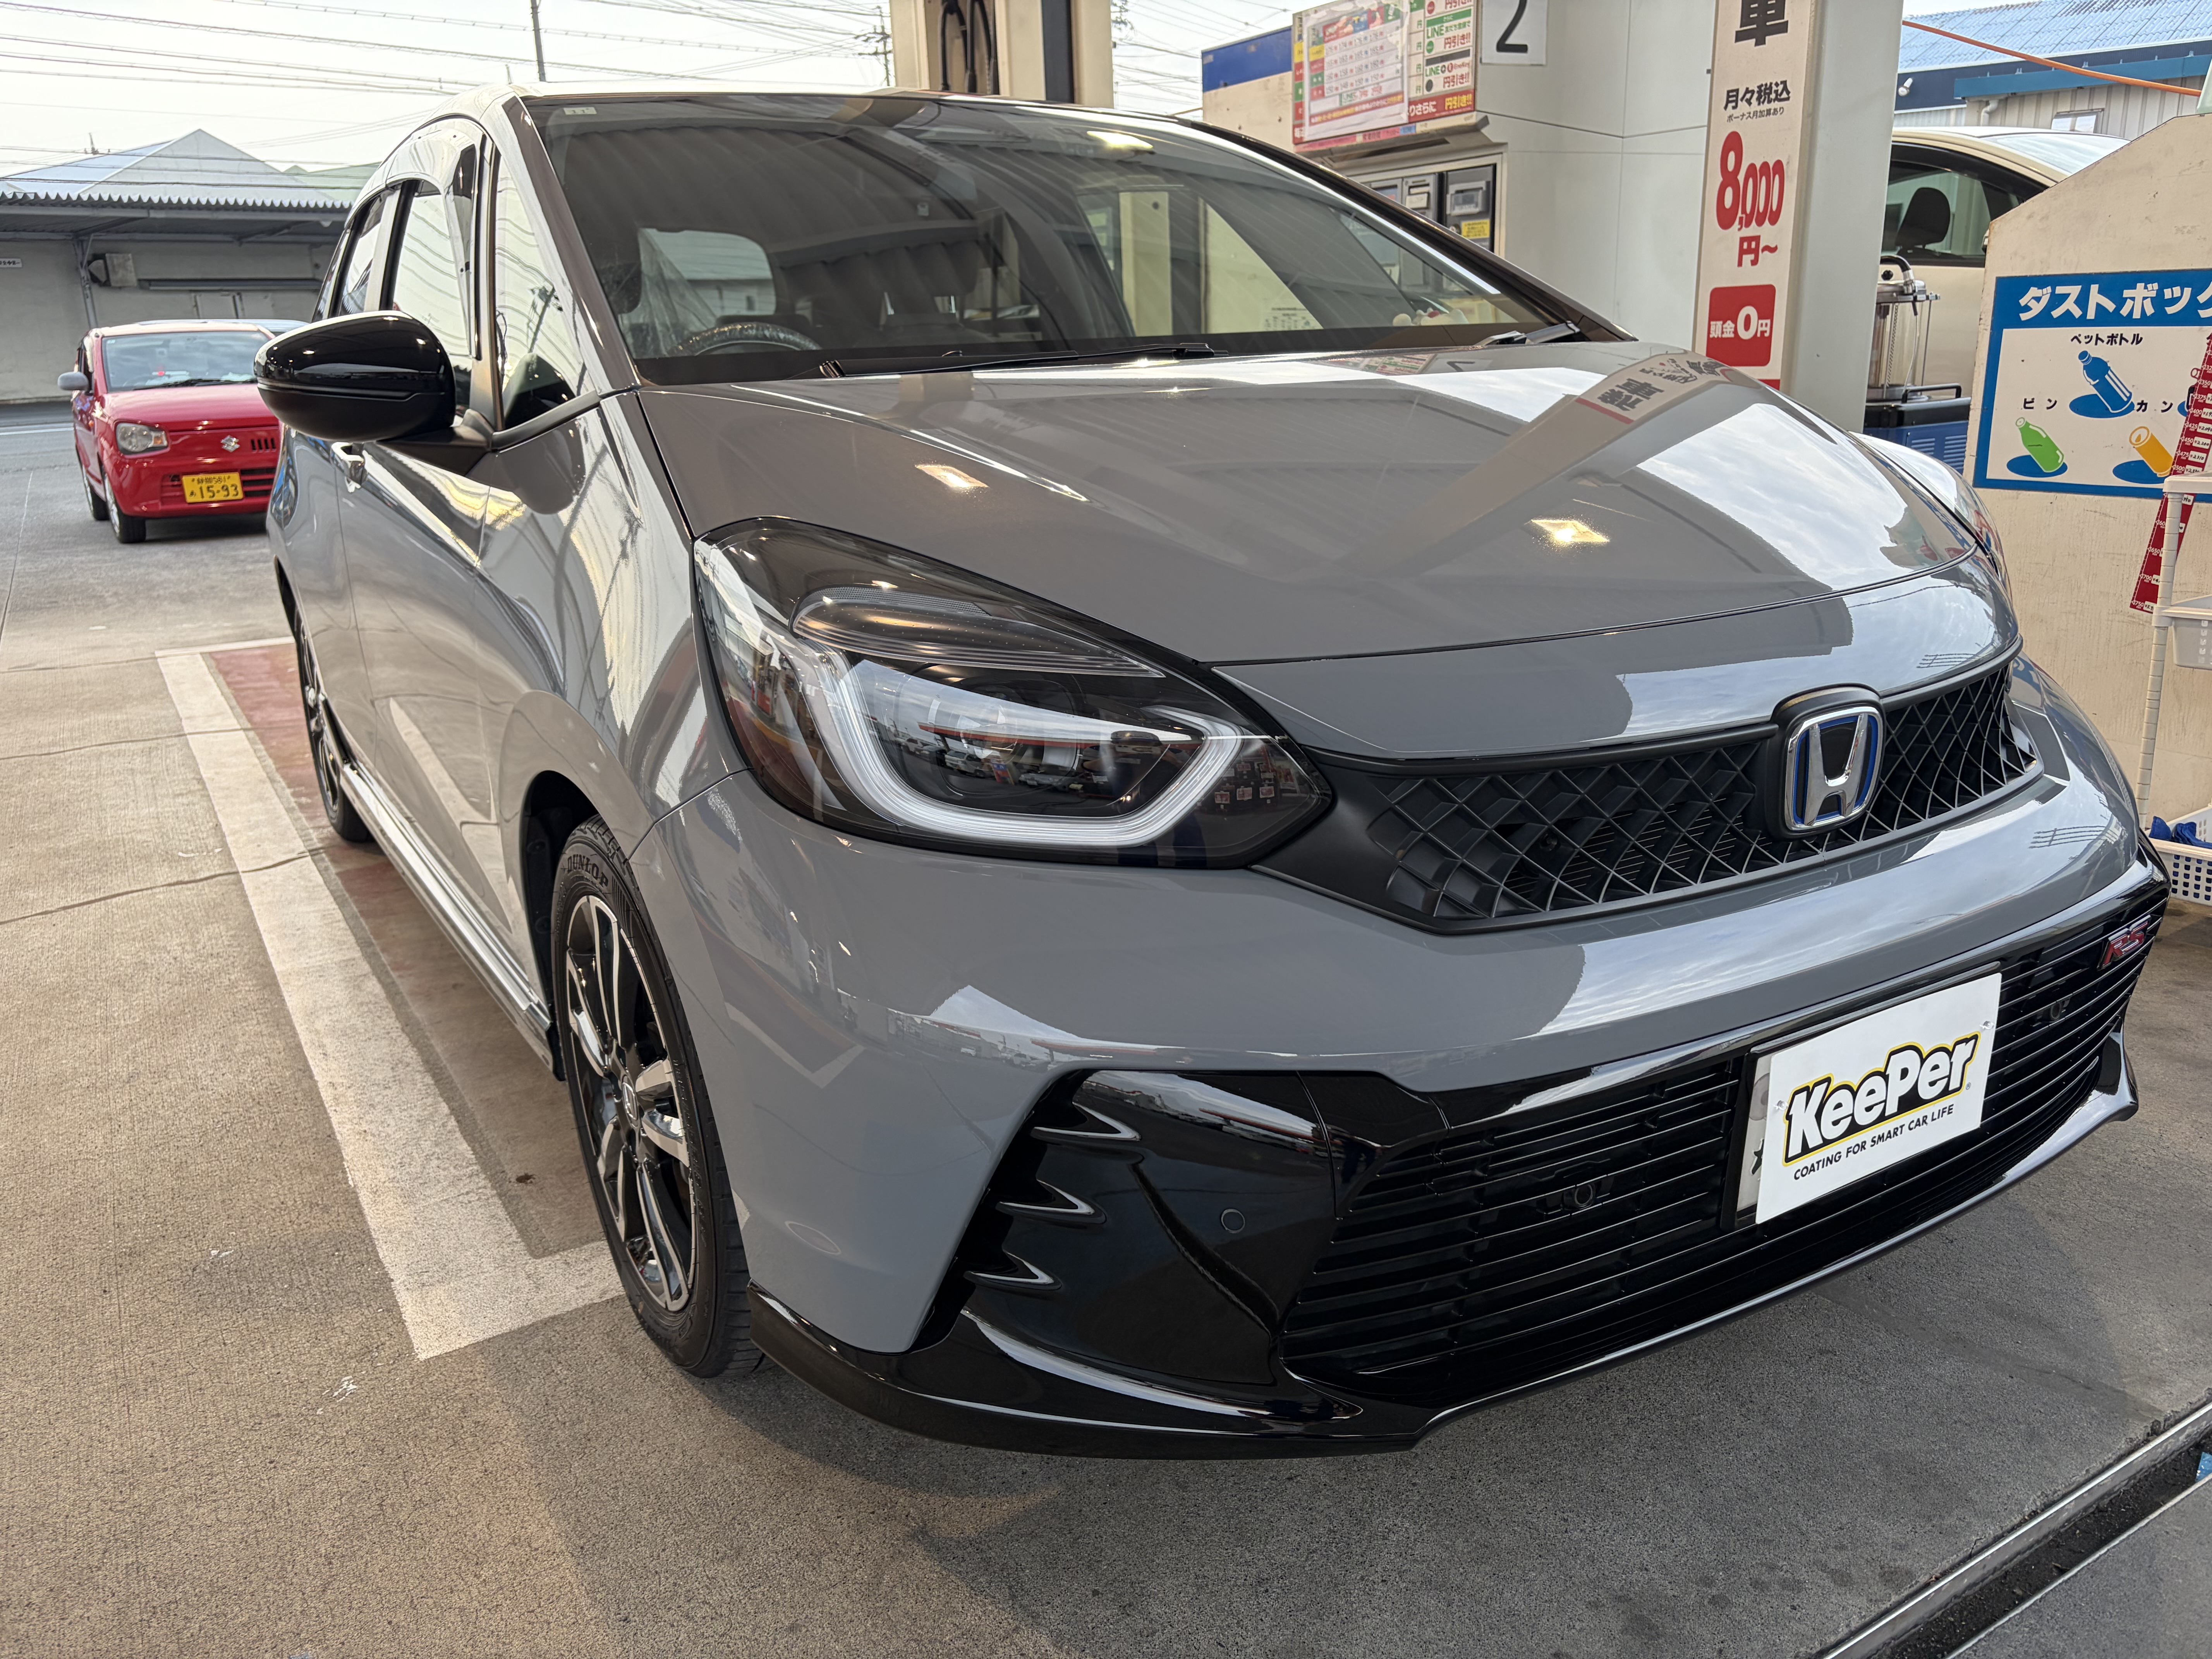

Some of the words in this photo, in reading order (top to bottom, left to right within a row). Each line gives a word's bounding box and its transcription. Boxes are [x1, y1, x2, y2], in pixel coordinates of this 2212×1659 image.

[1426, 25, 1444, 39] LINE
[1496, 0, 1528, 53] 2
[1735, 0, 1789, 46] 車
[1425, 65, 1440, 77] LINE
[1408, 101, 1437, 116] りさらに
[1724, 80, 1791, 111] 月々税込
[1727, 107, 1784, 123] ボーナス月加算あり
[1716, 131, 1784, 232] 8,000
[1710, 306, 1771, 340] 頭金0円
[2071, 333, 2143, 345] ペットボトル
[199, 484, 239, 499] 15-93
[567, 854, 609, 888] DUNLOP
[2097, 914, 2152, 970] RS
[1785, 1035, 1978, 1162] KeePer
[1794, 1151, 1842, 1180] COATING
[1846, 1140, 1867, 1158] FOR
[1870, 1124, 1905, 1147] SMART
[1908, 1115, 1928, 1131] CAR
[1931, 1104, 1954, 1121] LIFE
